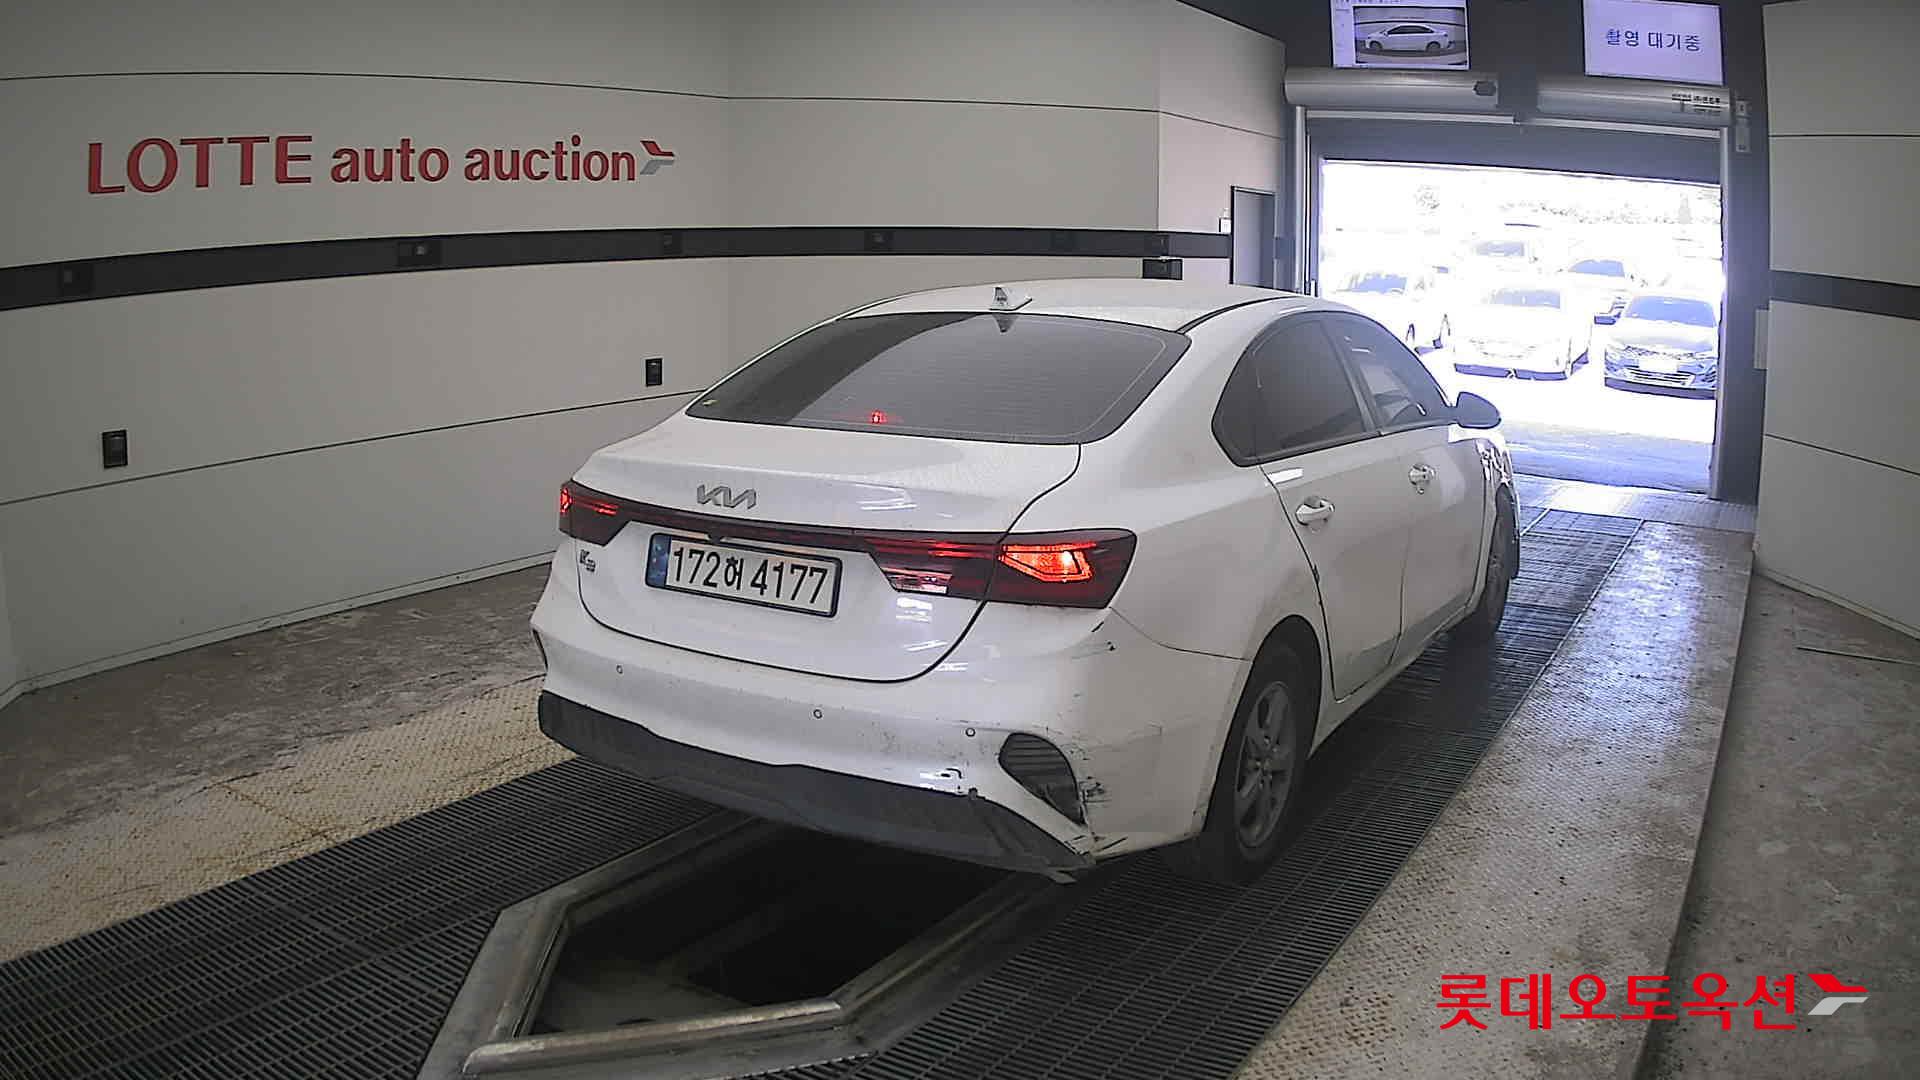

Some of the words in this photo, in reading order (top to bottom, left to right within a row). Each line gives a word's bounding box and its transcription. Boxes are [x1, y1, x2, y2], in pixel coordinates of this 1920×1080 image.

[1647, 32, 1700, 52] 대기중
[88, 135, 312, 194] LOTTE
[330, 138, 450, 183] auto
[463, 135, 637, 182] auction
[696, 484, 758, 510] KIA
[750, 559, 828, 605] 4177
